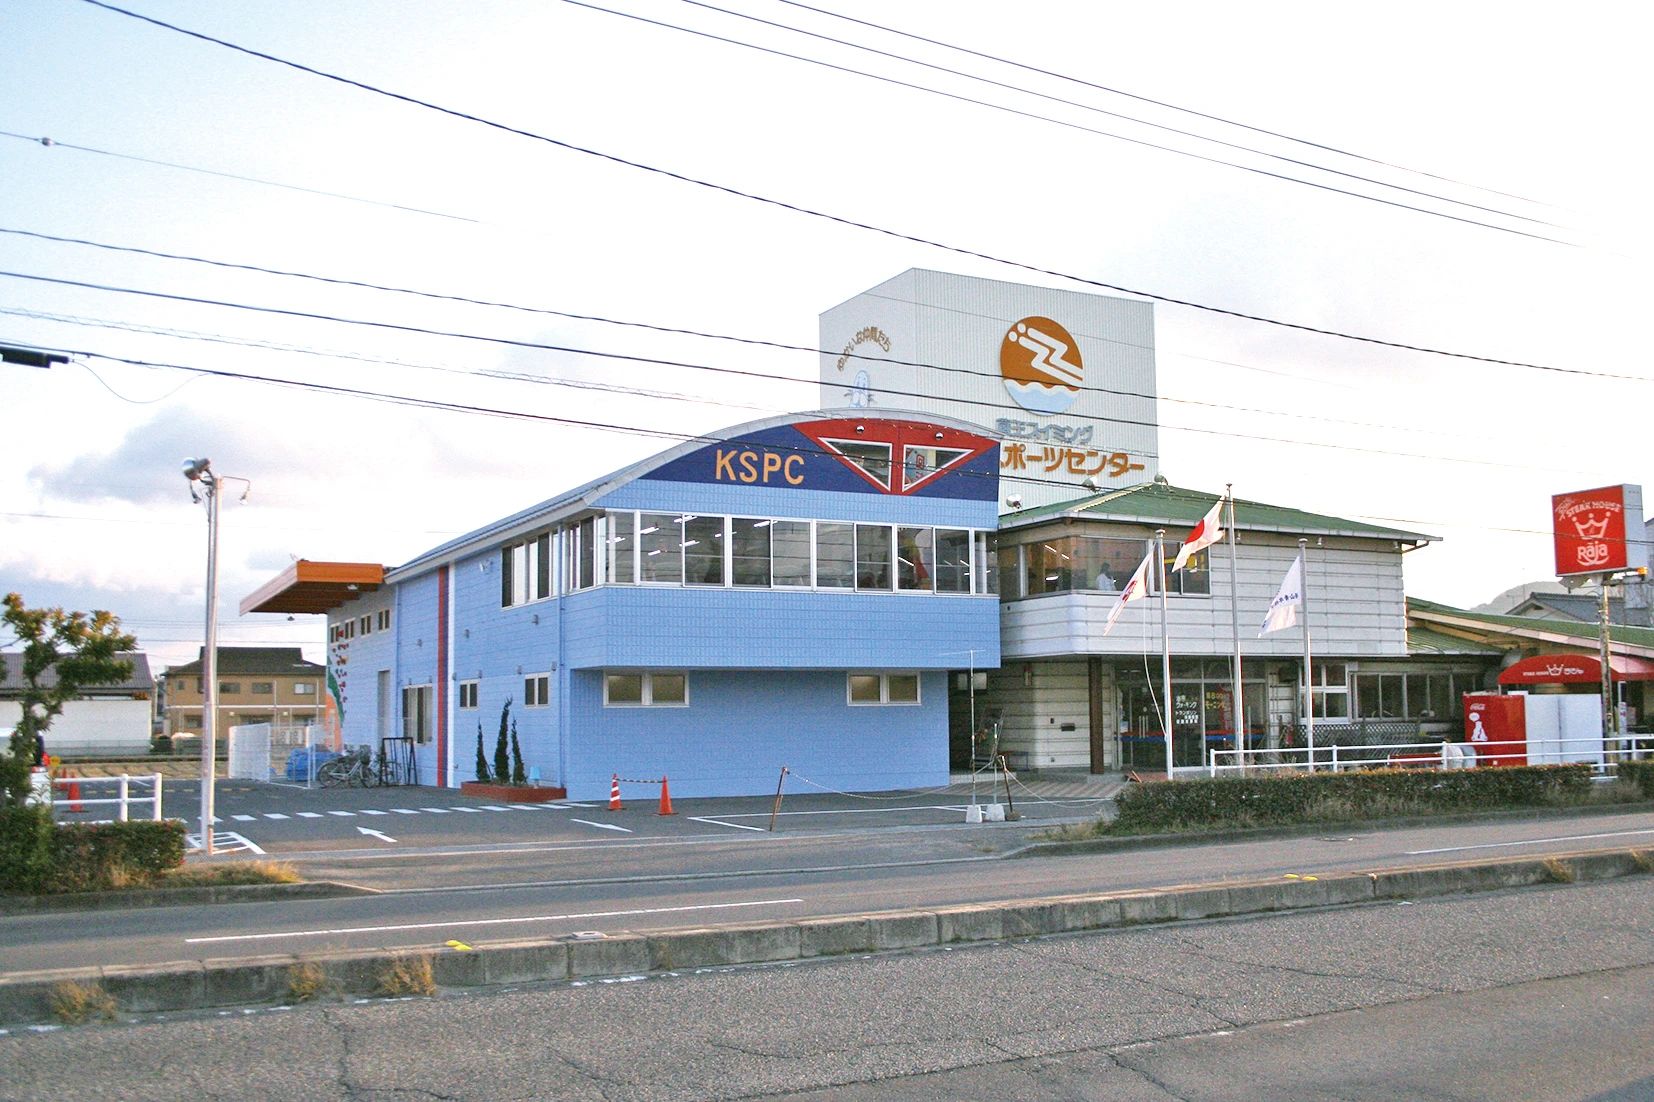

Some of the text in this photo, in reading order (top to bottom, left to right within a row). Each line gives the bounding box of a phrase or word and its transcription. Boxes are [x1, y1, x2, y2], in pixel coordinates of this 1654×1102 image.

[716, 449, 805, 485] KSPC
[1001, 443, 1145, 477] ポーツセンター
